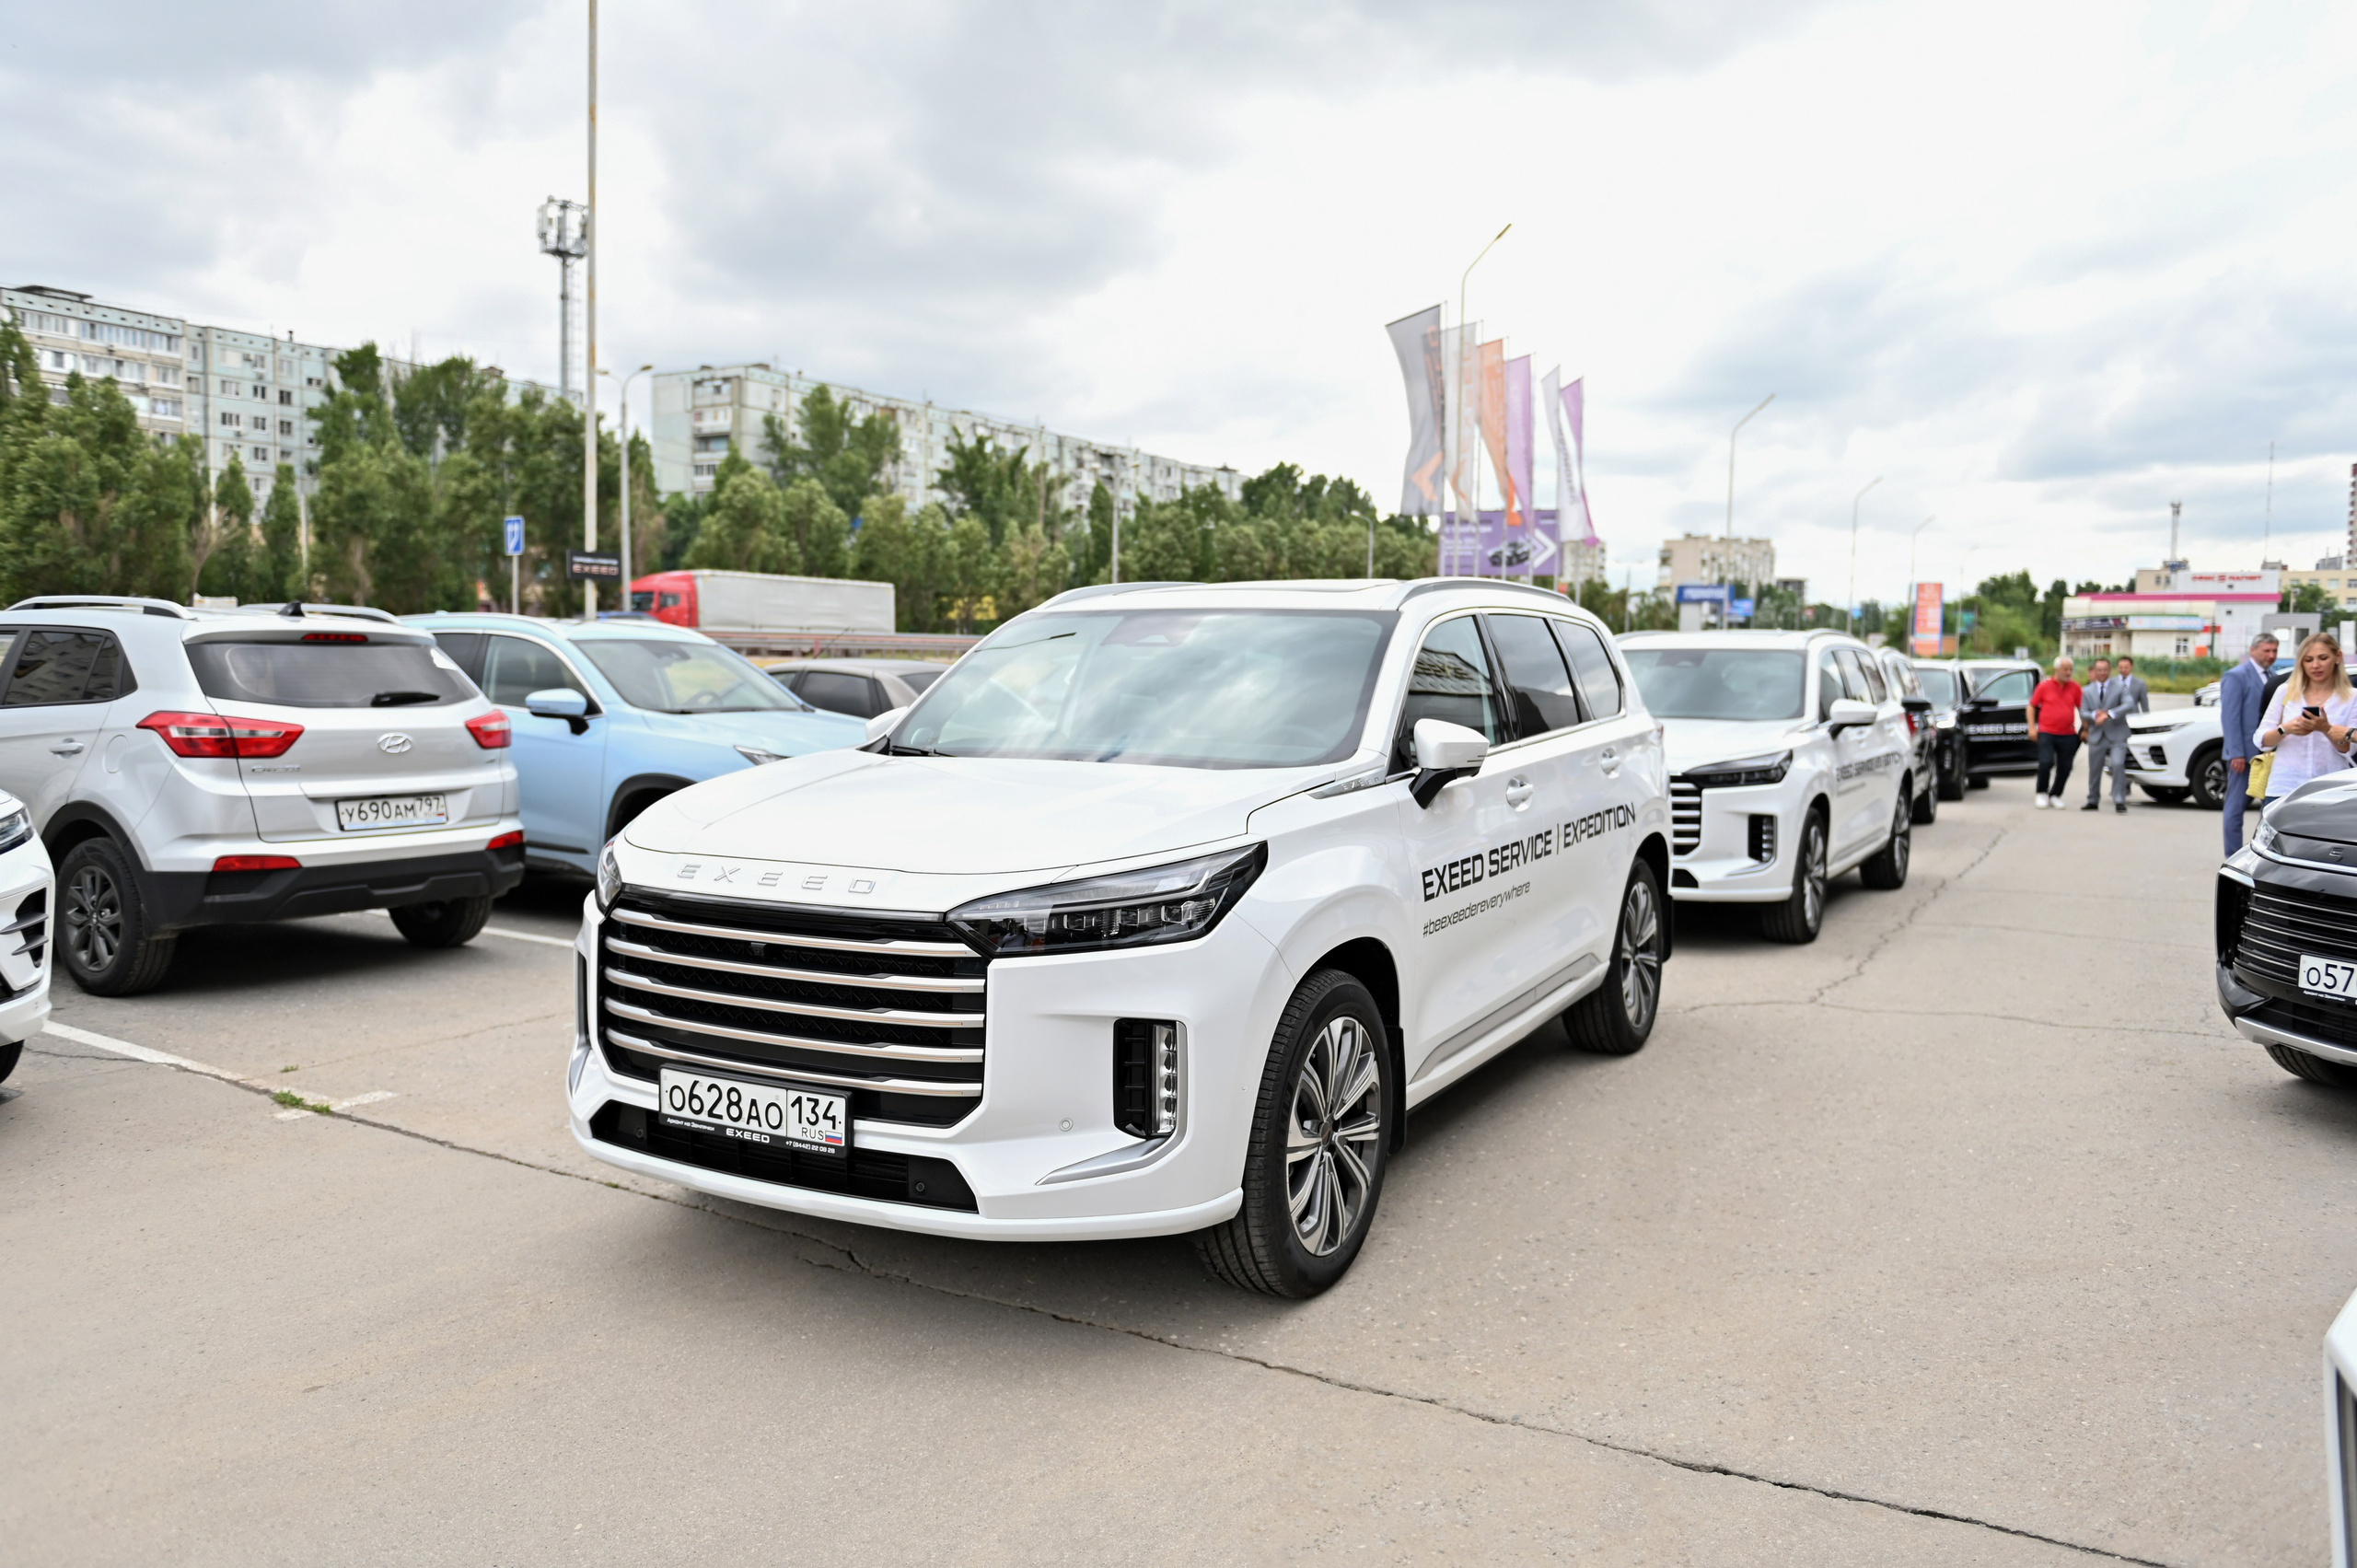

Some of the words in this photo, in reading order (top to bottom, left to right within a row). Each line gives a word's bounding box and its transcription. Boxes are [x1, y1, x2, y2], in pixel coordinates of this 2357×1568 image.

[415, 796, 440, 811] 797
[1422, 854, 1484, 902] EXEED
[1489, 830, 1552, 877] SERVICE
[1563, 802, 1636, 849] EXPEDITION
[677, 864, 877, 894] EXEED
[1422, 881, 1531, 938] #beexeedereverywhere
[669, 1080, 783, 1130] О628АО
[790, 1096, 836, 1130] 134
[726, 1128, 770, 1144] EXEED
[801, 1127, 824, 1140] RUS
[793, 1141, 810, 1150] (8442)
